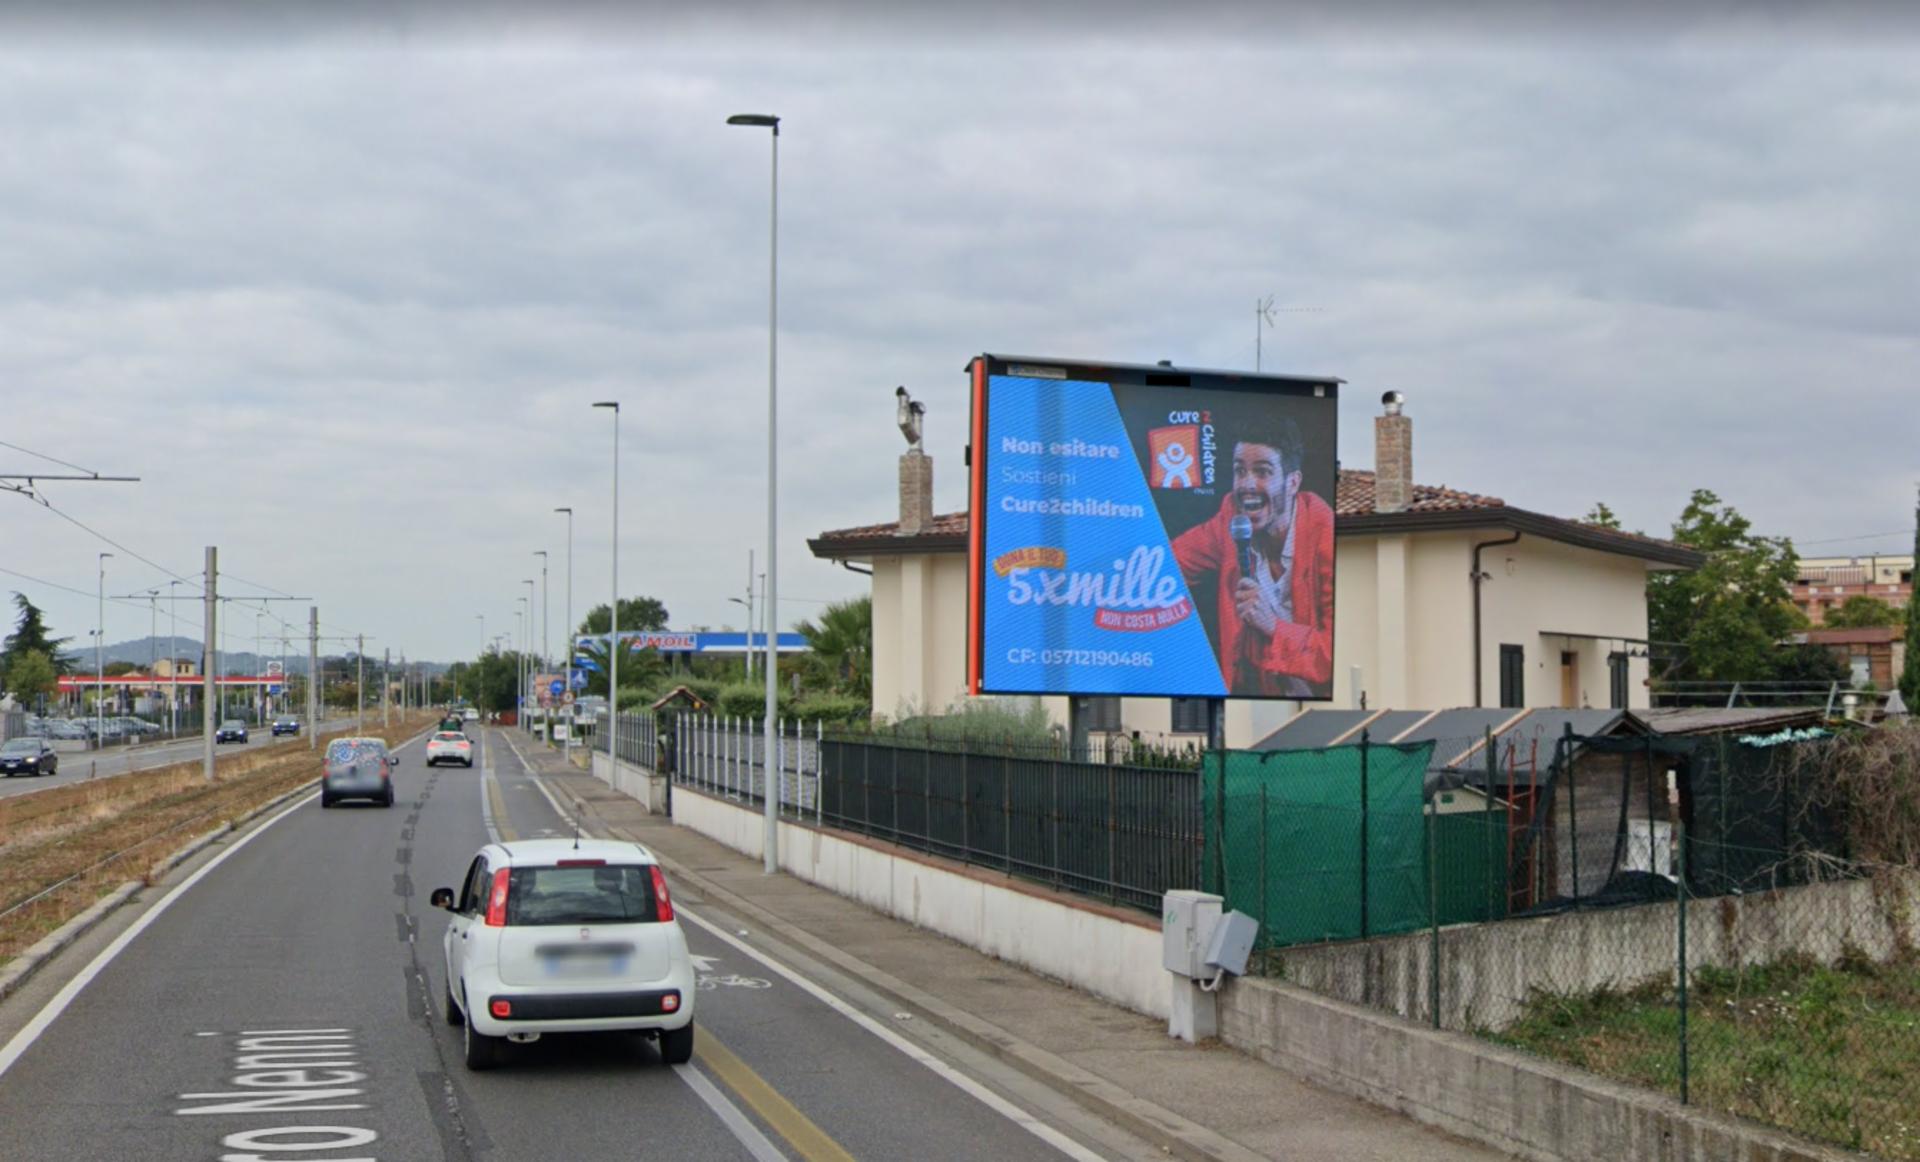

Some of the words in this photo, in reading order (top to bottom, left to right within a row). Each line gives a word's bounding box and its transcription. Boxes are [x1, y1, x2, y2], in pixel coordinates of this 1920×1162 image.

[1002, 436, 1044, 455] Non
[1050, 437, 1120, 460] esitare
[1002, 465, 1077, 486] Sostieni
[1001, 496, 1144, 519] Cure2children
[1124, 613, 1157, 629] COSTA
[1006, 648, 1037, 665] CF:
[1041, 649, 1154, 667] 05712190486
